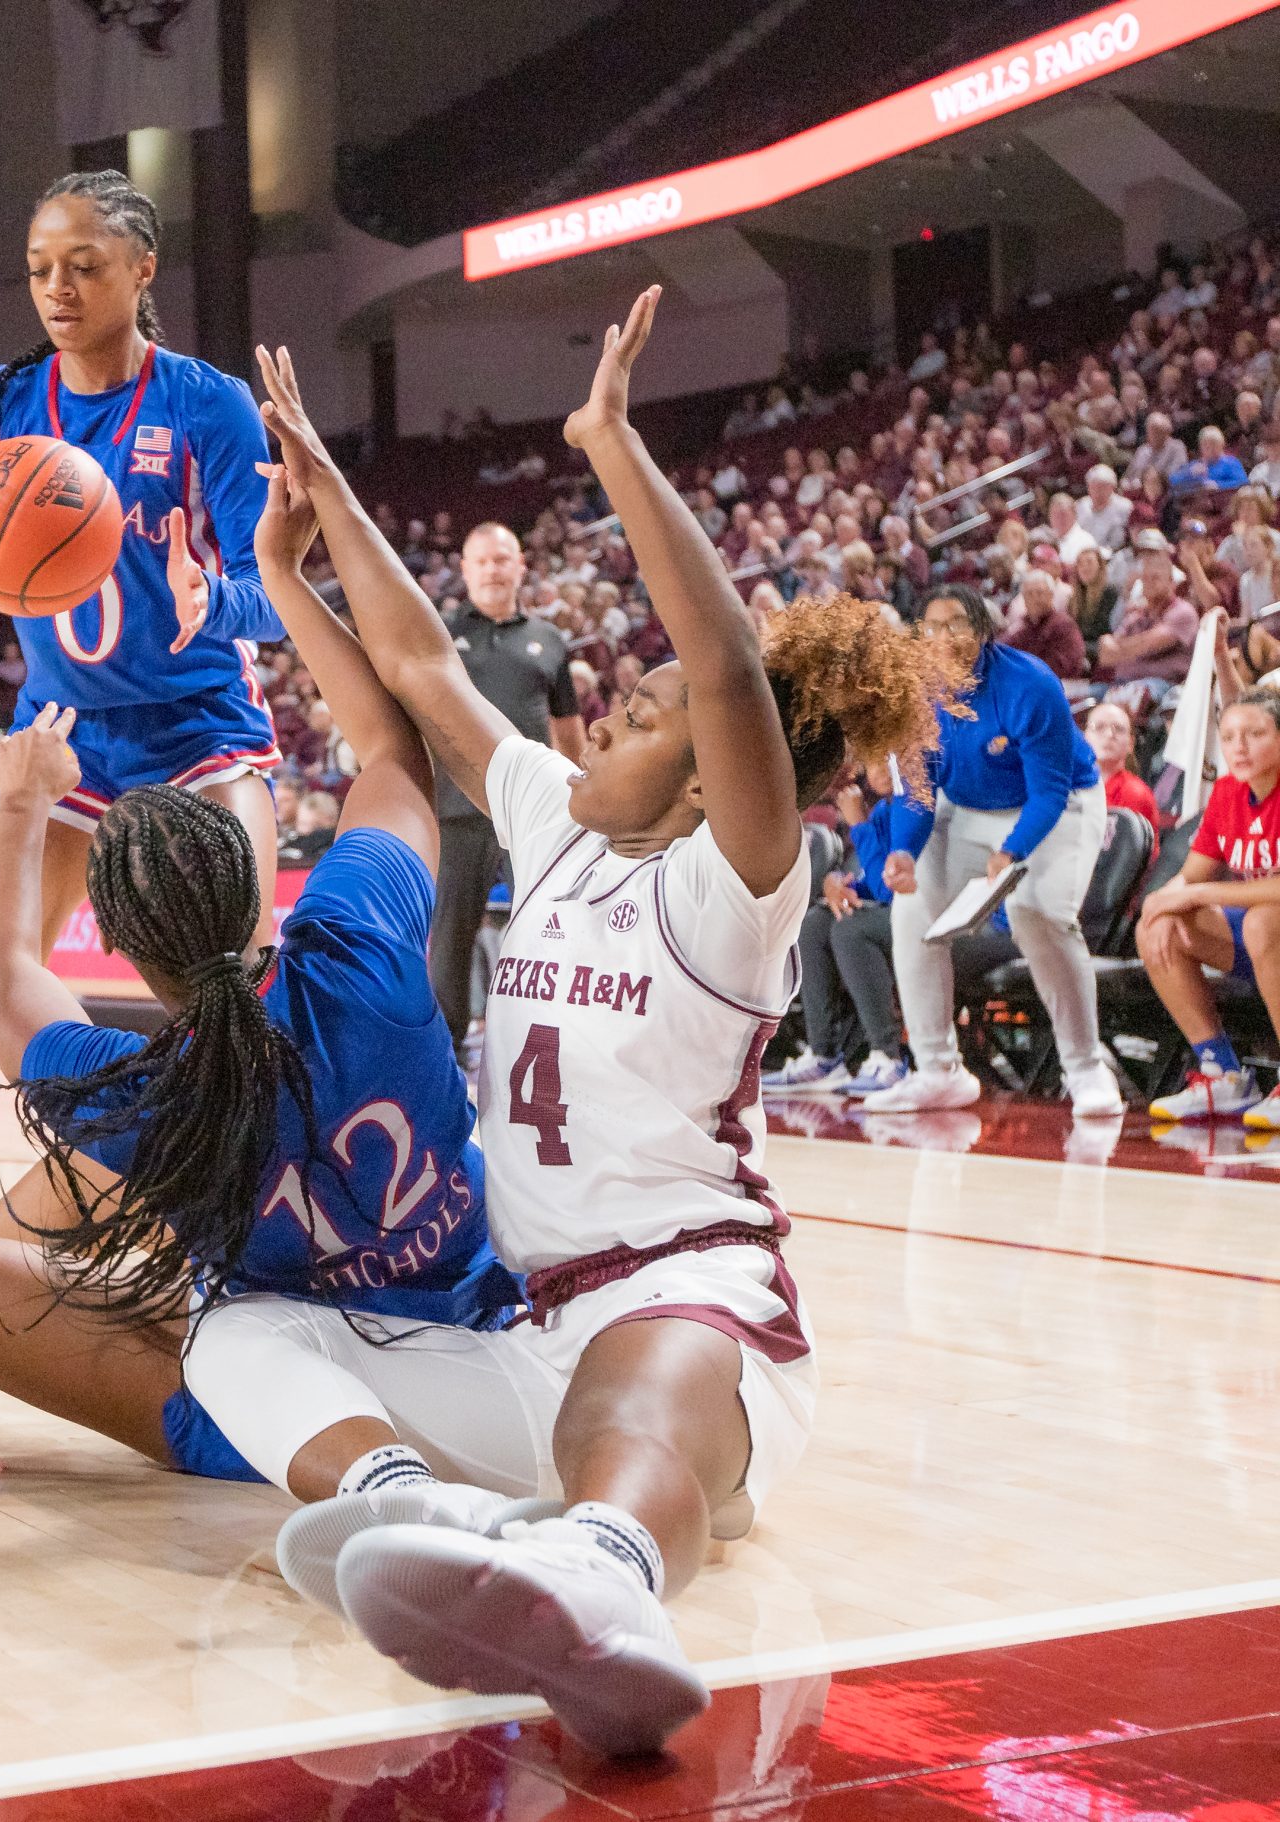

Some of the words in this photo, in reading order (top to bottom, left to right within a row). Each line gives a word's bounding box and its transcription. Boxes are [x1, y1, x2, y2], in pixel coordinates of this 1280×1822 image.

[931, 57, 1030, 122] WELLS
[1034, 13, 1140, 84] FARGO
[495, 212, 586, 260] WELLS
[588, 187, 683, 238] FARGO
[34, 459, 74, 508] adidas
[129, 451, 172, 477] XII
[54, 575, 123, 664] 0
[540, 928, 566, 940] adidas
[611, 903, 636, 929] SEC
[489, 956, 559, 1001] TEXAS
[567, 965, 652, 1016] A&M
[509, 1023, 573, 1166] 4
[262, 1099, 439, 1264] 12
